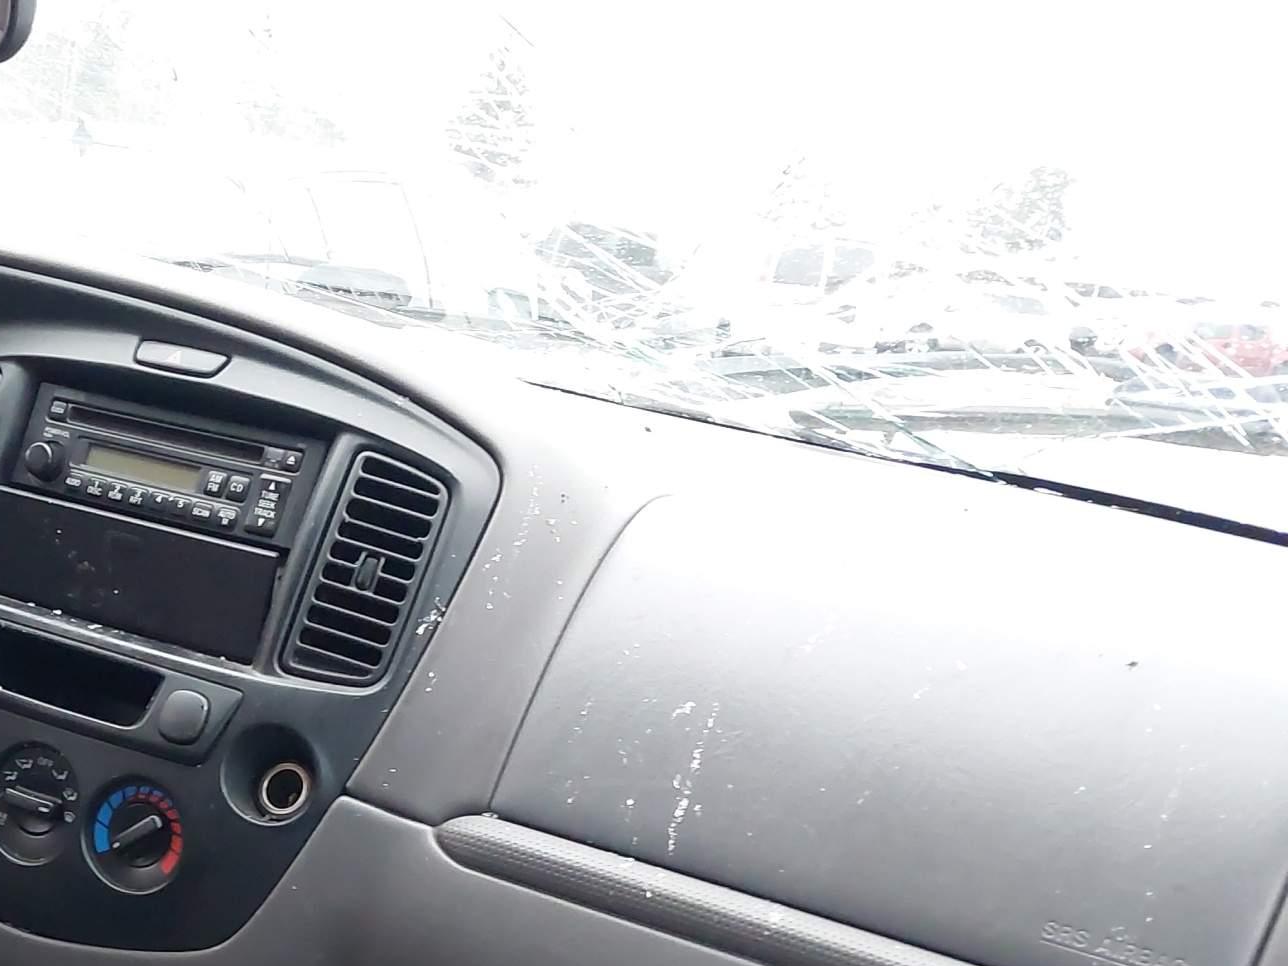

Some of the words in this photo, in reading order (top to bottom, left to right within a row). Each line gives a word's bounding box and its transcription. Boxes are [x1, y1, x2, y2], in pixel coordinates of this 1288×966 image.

[230, 482, 243, 492] CD
[258, 499, 276, 509] SEEK
[192, 507, 211, 517] SCAN
[254, 507, 277, 518] TRACK
